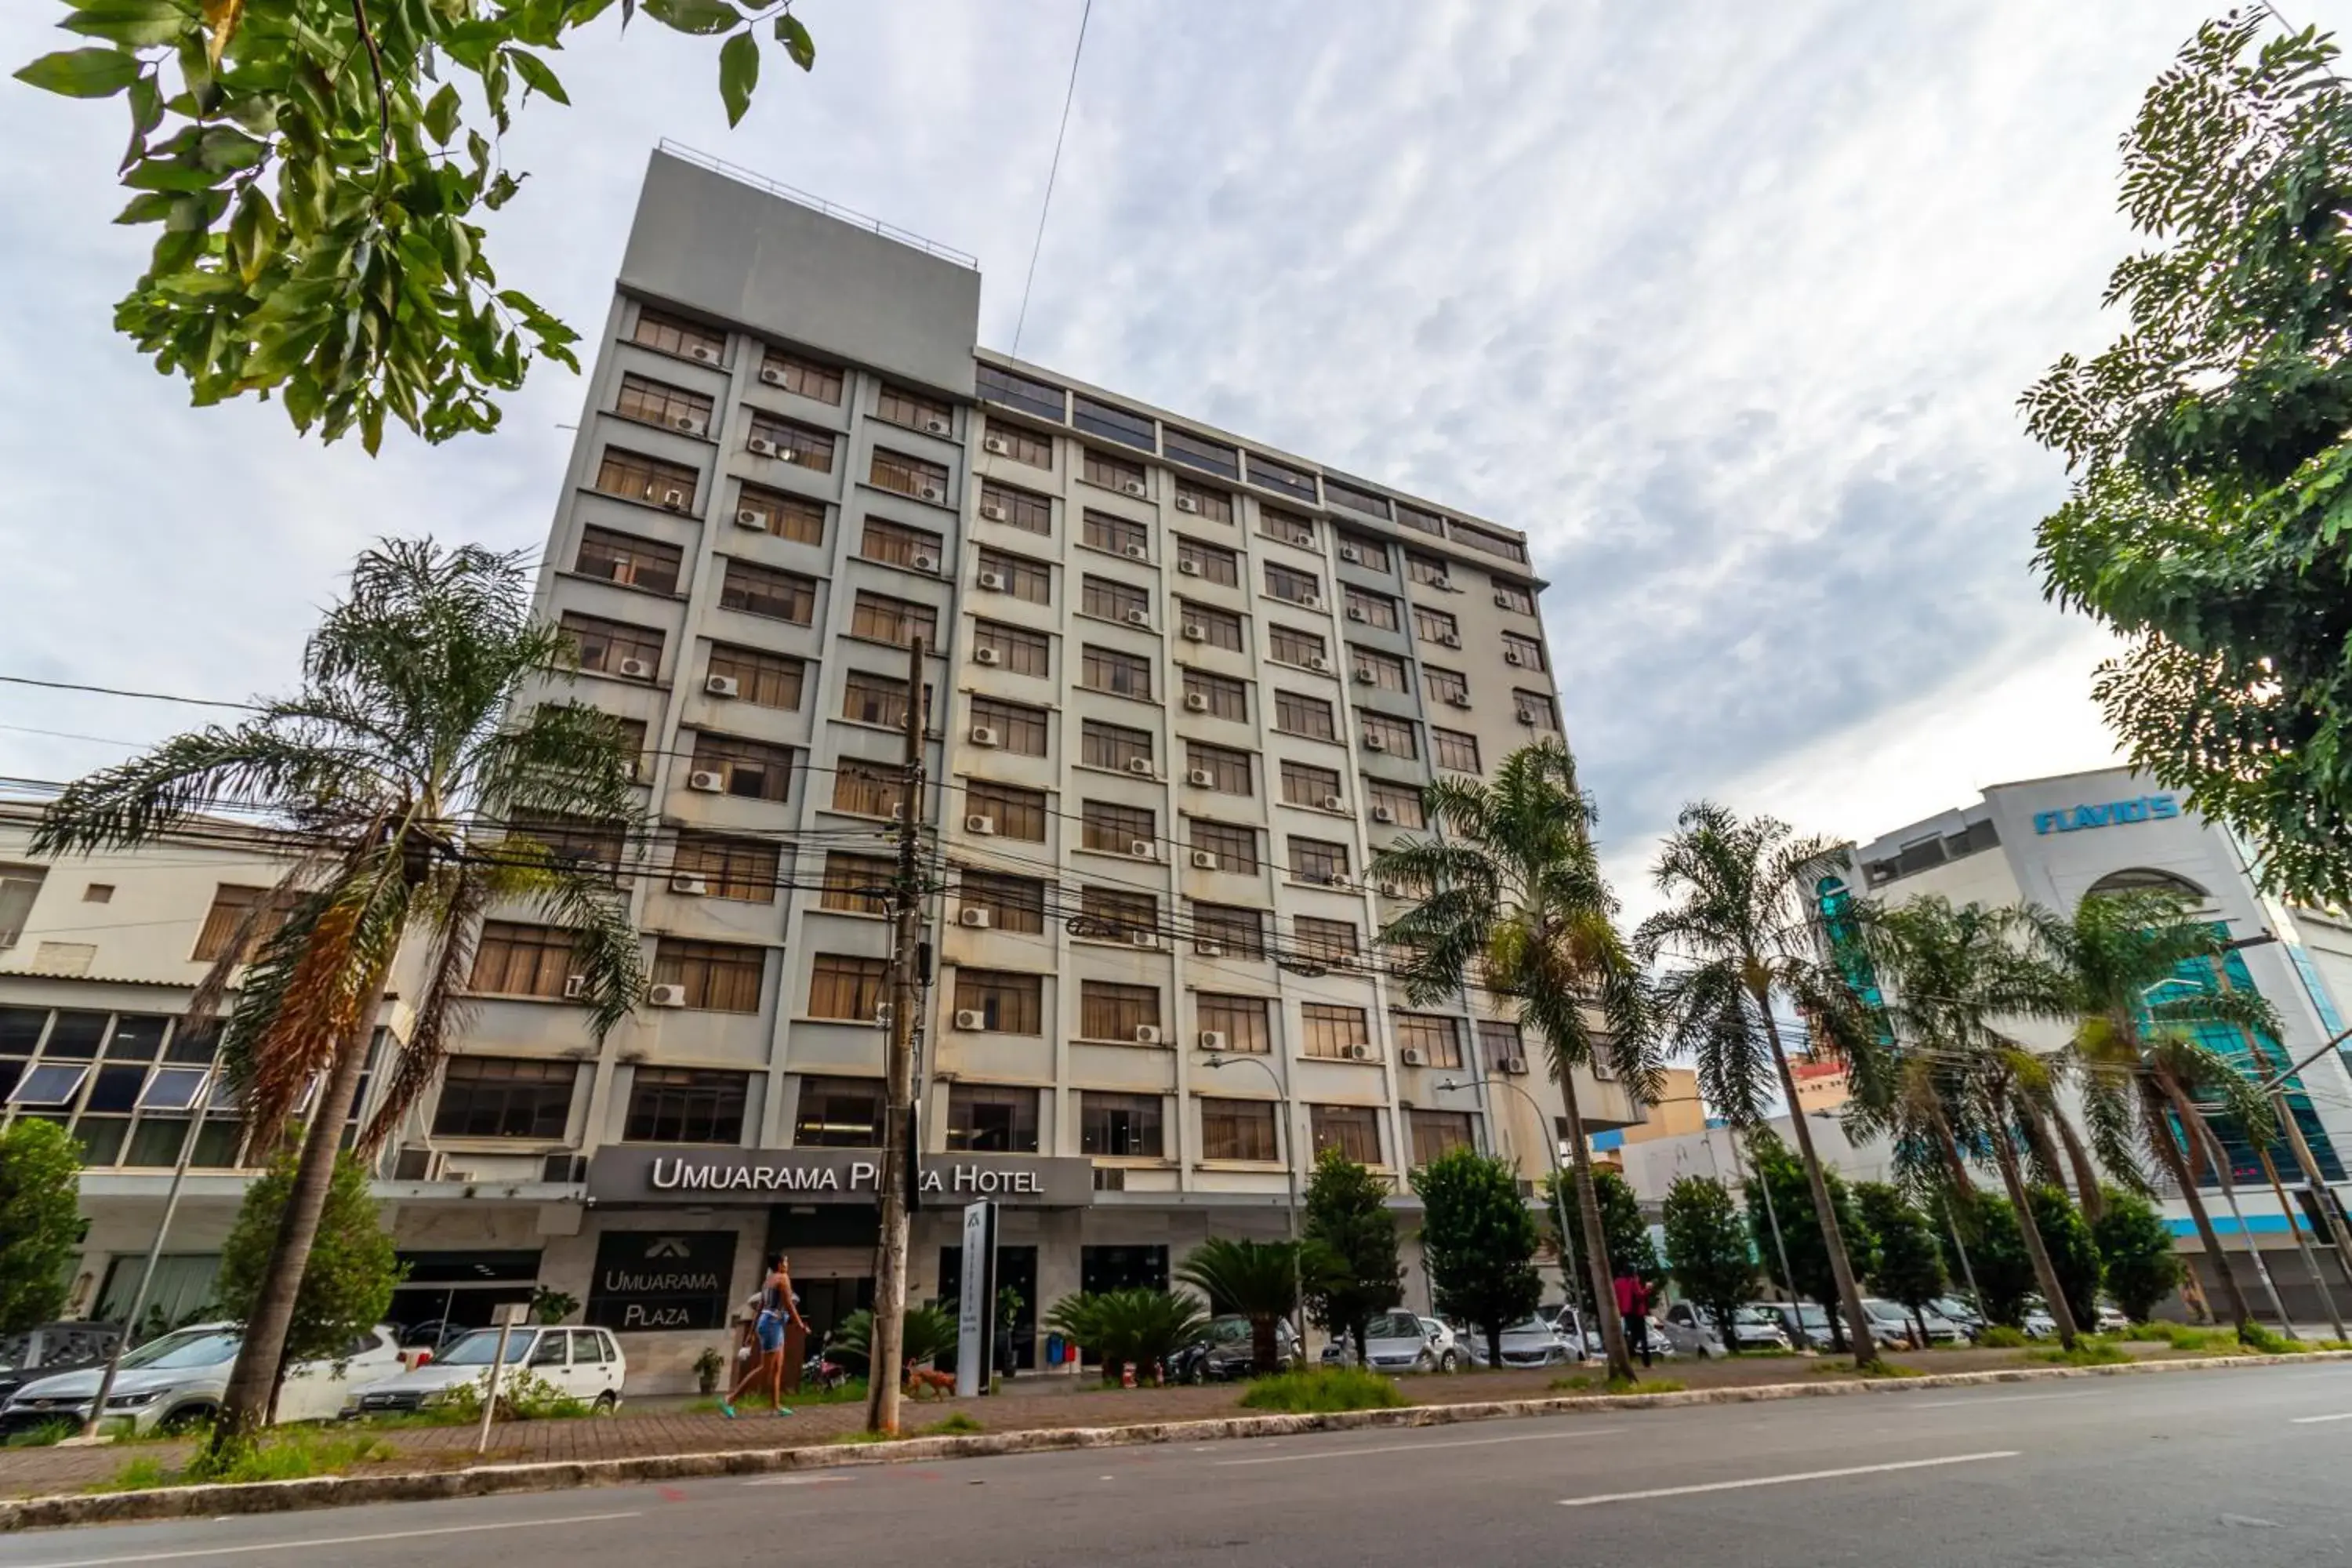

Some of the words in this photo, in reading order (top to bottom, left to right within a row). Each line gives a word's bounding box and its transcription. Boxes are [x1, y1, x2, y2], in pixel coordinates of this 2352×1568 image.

[652, 1157, 838, 1189] UMUARAMA
[954, 1163, 1044, 1192] HOTEL
[606, 1270, 718, 1291] UMUARAMA
[624, 1305, 690, 1327] PLAZA
